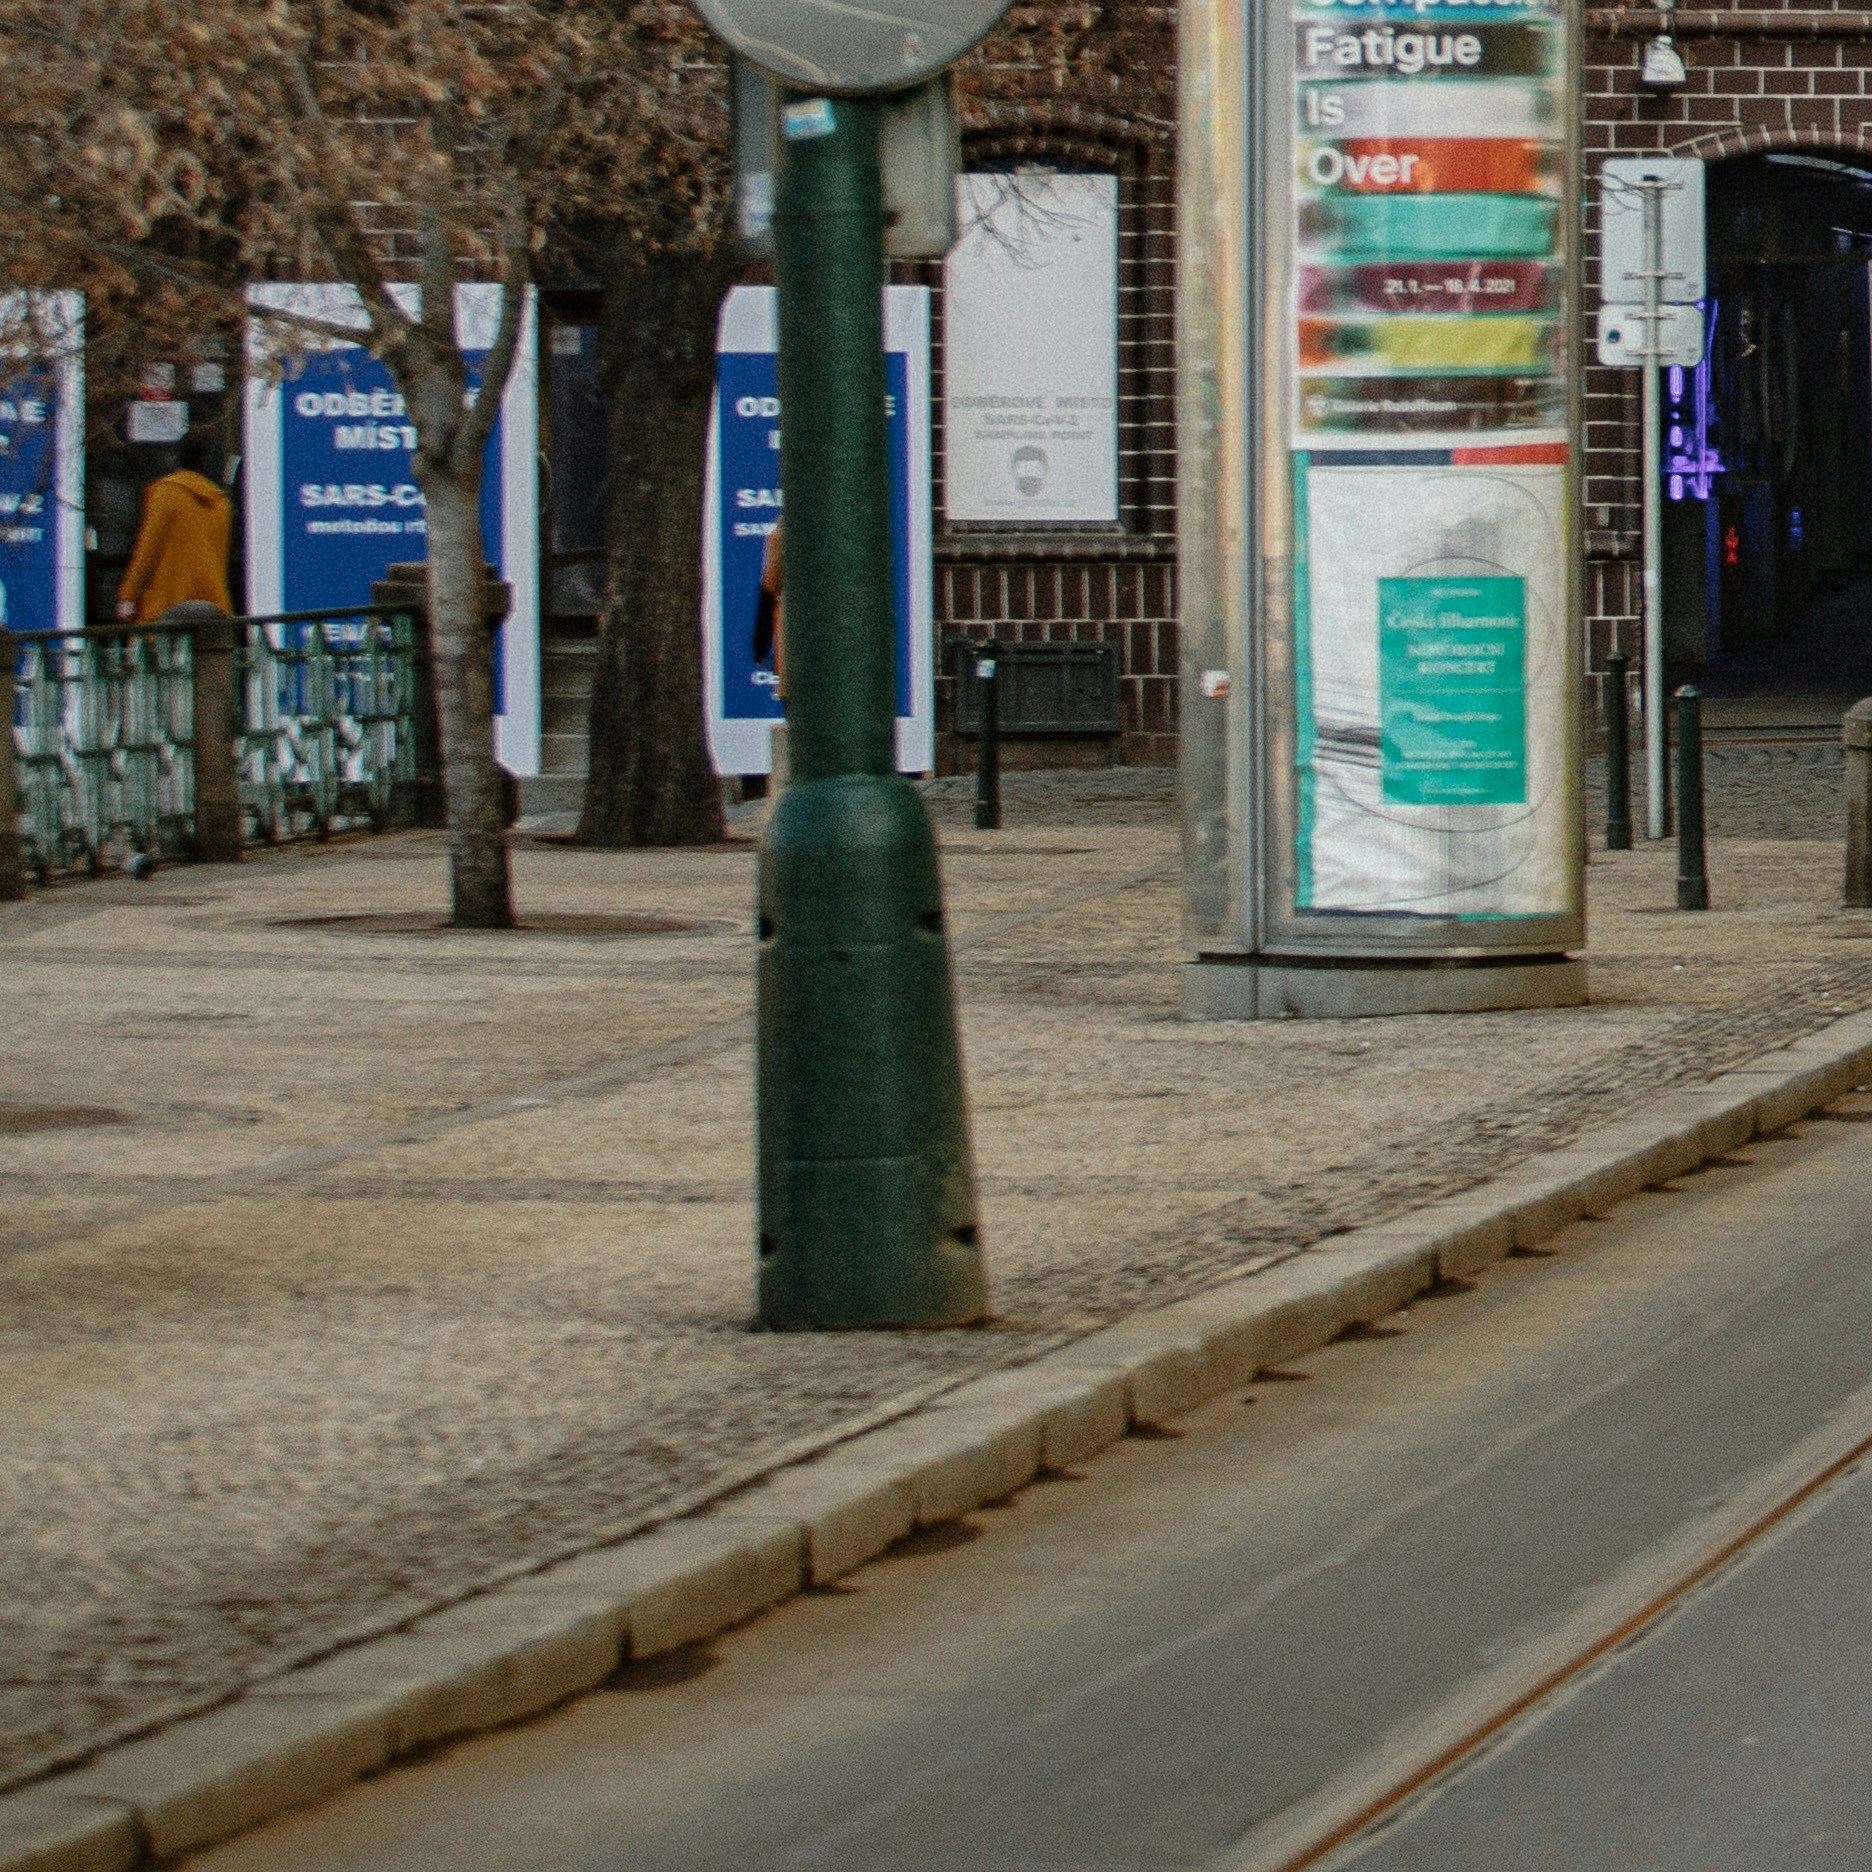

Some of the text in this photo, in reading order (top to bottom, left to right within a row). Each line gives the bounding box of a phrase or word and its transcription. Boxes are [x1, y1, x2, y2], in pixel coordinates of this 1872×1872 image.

[1305, 26, 1481, 73] Fatigue
[1306, 89, 1346, 125] Is
[1308, 147, 1419, 185] Over
